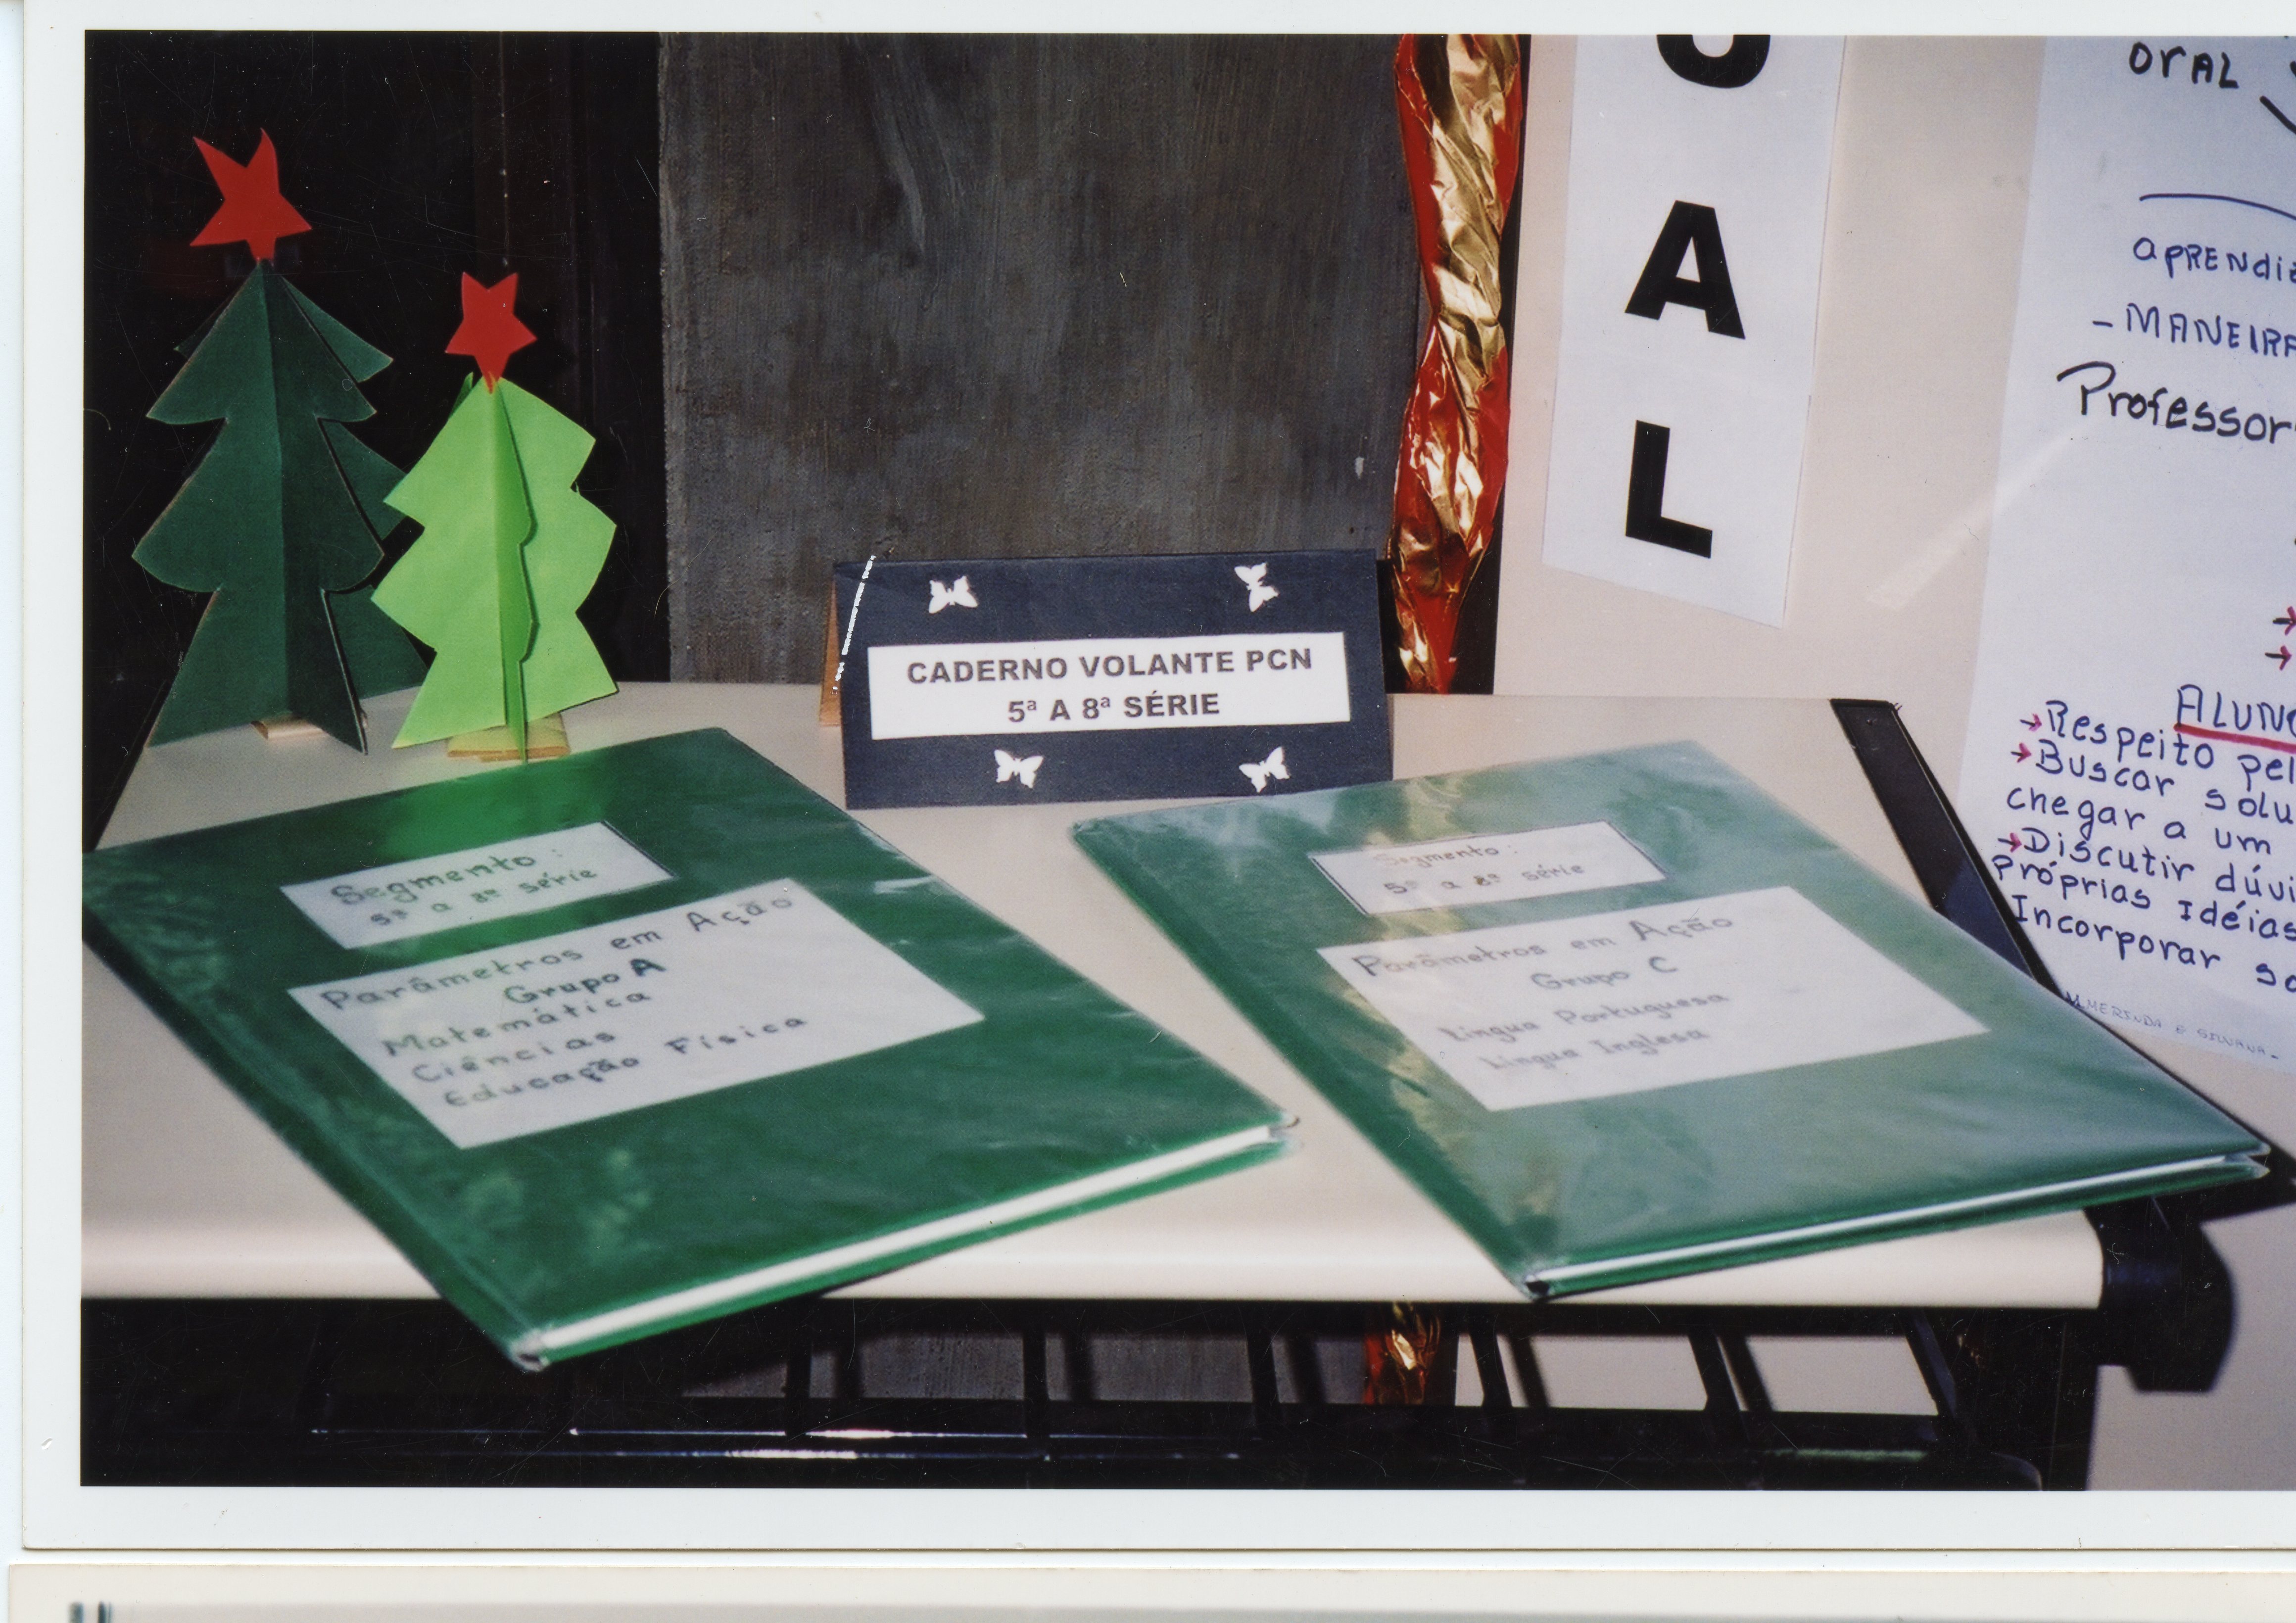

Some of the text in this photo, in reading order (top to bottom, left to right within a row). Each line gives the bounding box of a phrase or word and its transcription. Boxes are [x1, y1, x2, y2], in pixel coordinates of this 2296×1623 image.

[907, 647, 1313, 684] CADERNO VOLANTE PCN
[1007, 691, 1220, 723] 5ª A 8ª SÉRIE
[2046, 700, 2214, 769] Respeito
[2035, 738, 2175, 796] Buscar
[2021, 827, 2195, 881] Discutir
[2163, 821, 2186, 839] a
[2215, 827, 2271, 855] um
[319, 896, 794, 1011] Parâmetros em Ação
[1570, 936, 1618, 950] em
[1627, 915, 1735, 942] Ação
[2011, 894, 2221, 969] Incorporar
[502, 957, 668, 1005] Grupo A
[1529, 955, 1680, 990] Grupo C
[381, 988, 653, 1057] Matemática
[1554, 994, 1732, 1020] Portuguesa
[412, 1029, 617, 1084] Ciências
[443, 1055, 641, 1108] Educação
